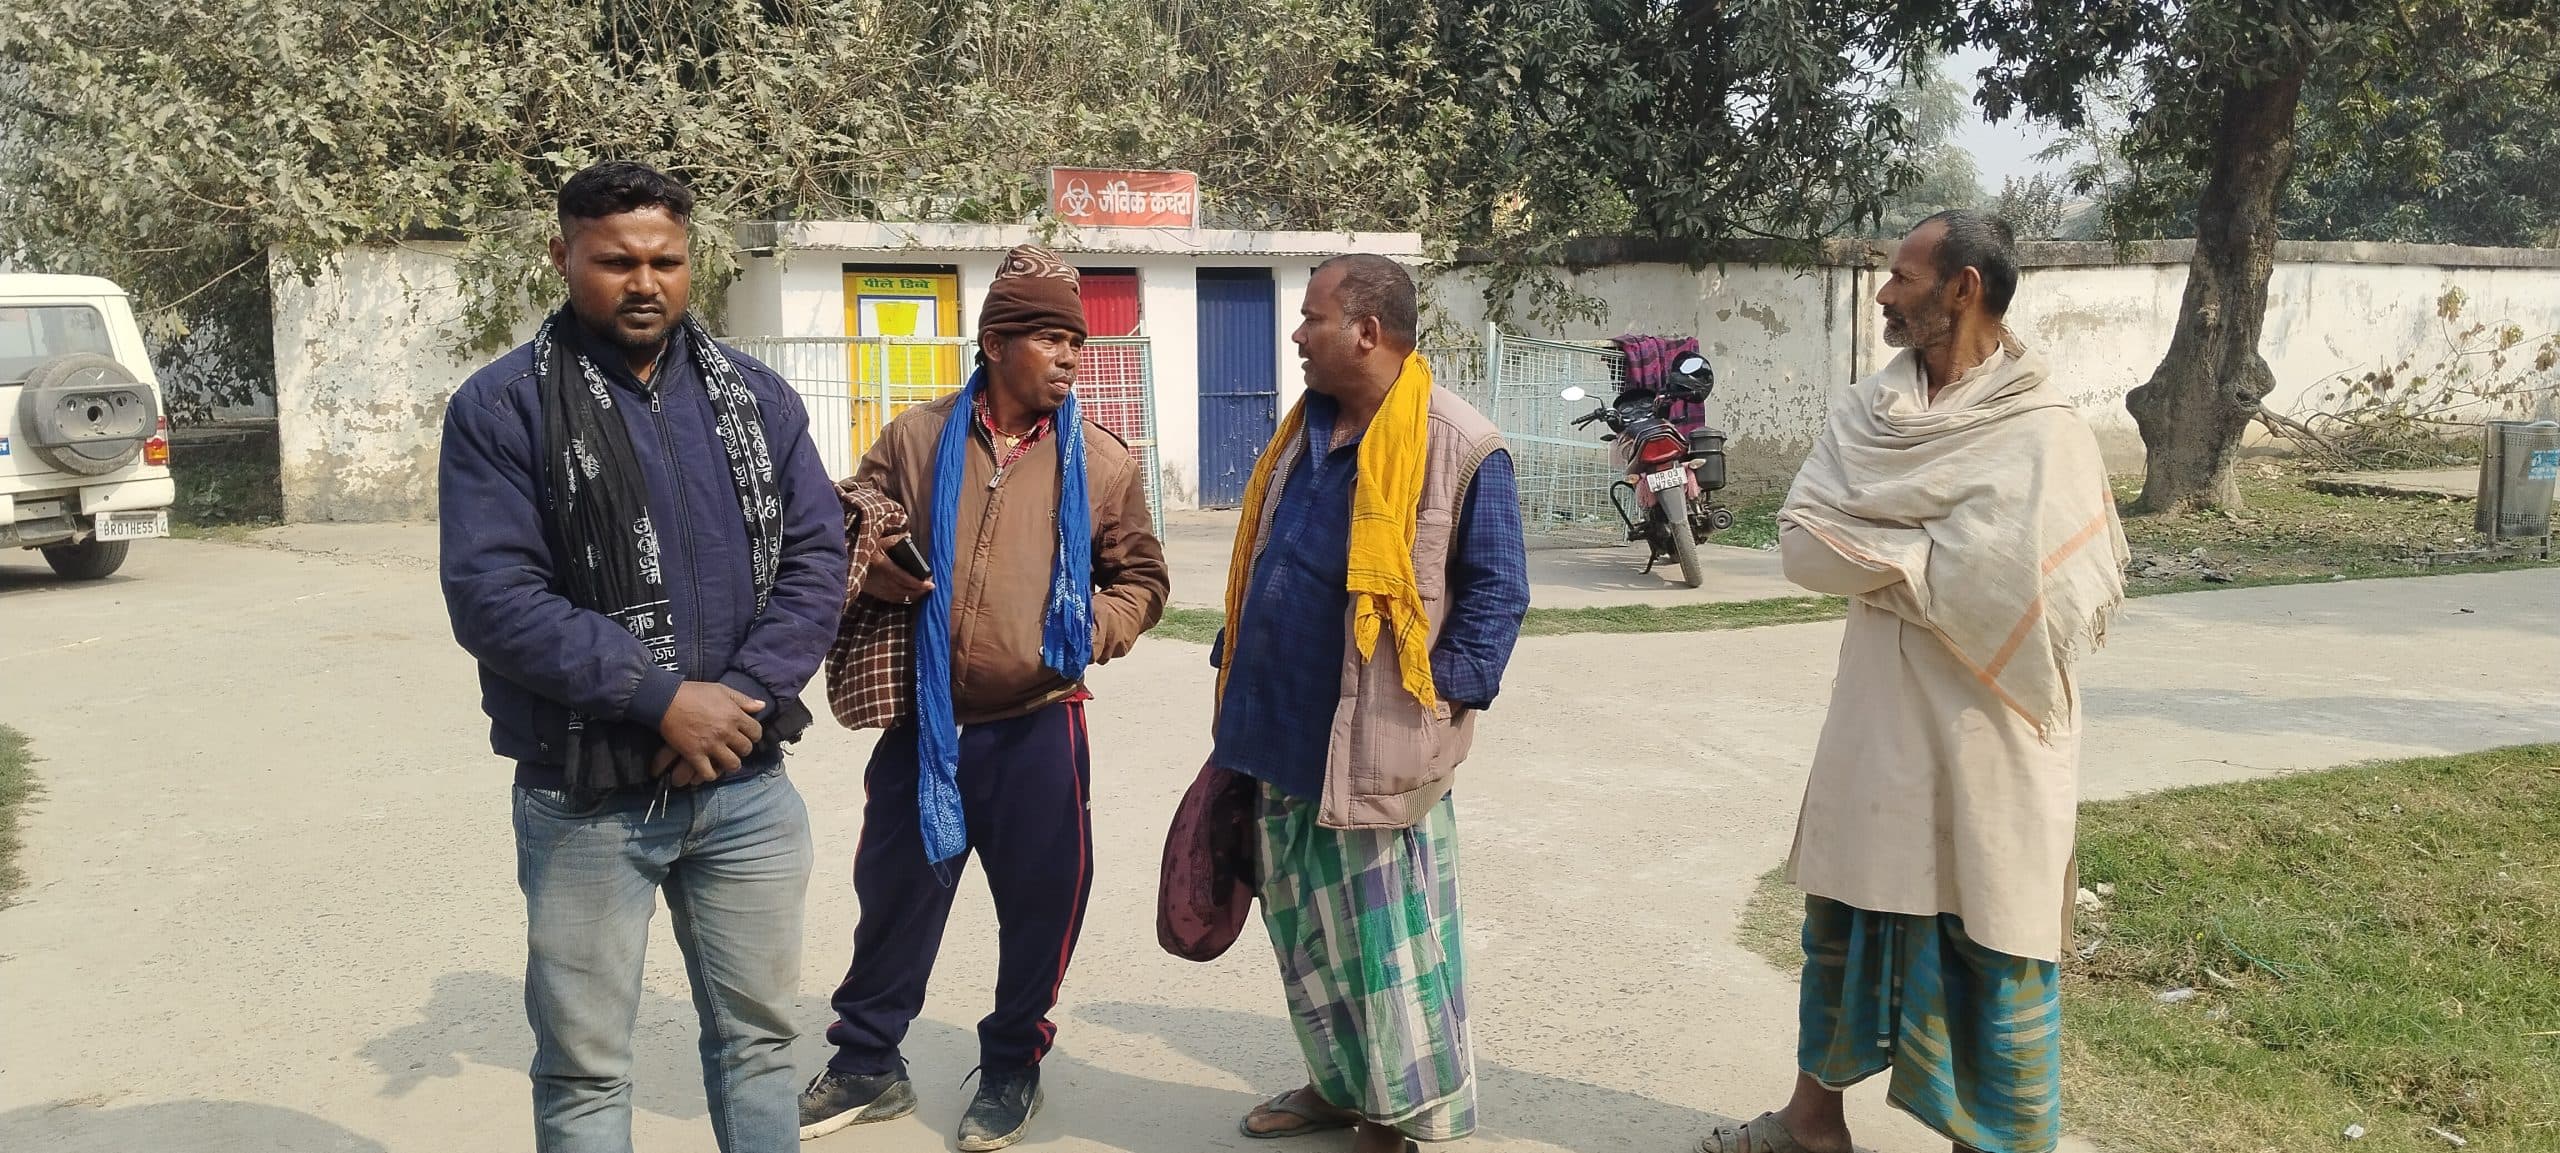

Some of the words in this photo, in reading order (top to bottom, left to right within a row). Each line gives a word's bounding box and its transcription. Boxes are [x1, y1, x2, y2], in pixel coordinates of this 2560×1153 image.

[1097, 180, 1147, 214] जैविक
[1150, 192, 1191, 214] कचरा
[864, 278, 893, 289] पीले
